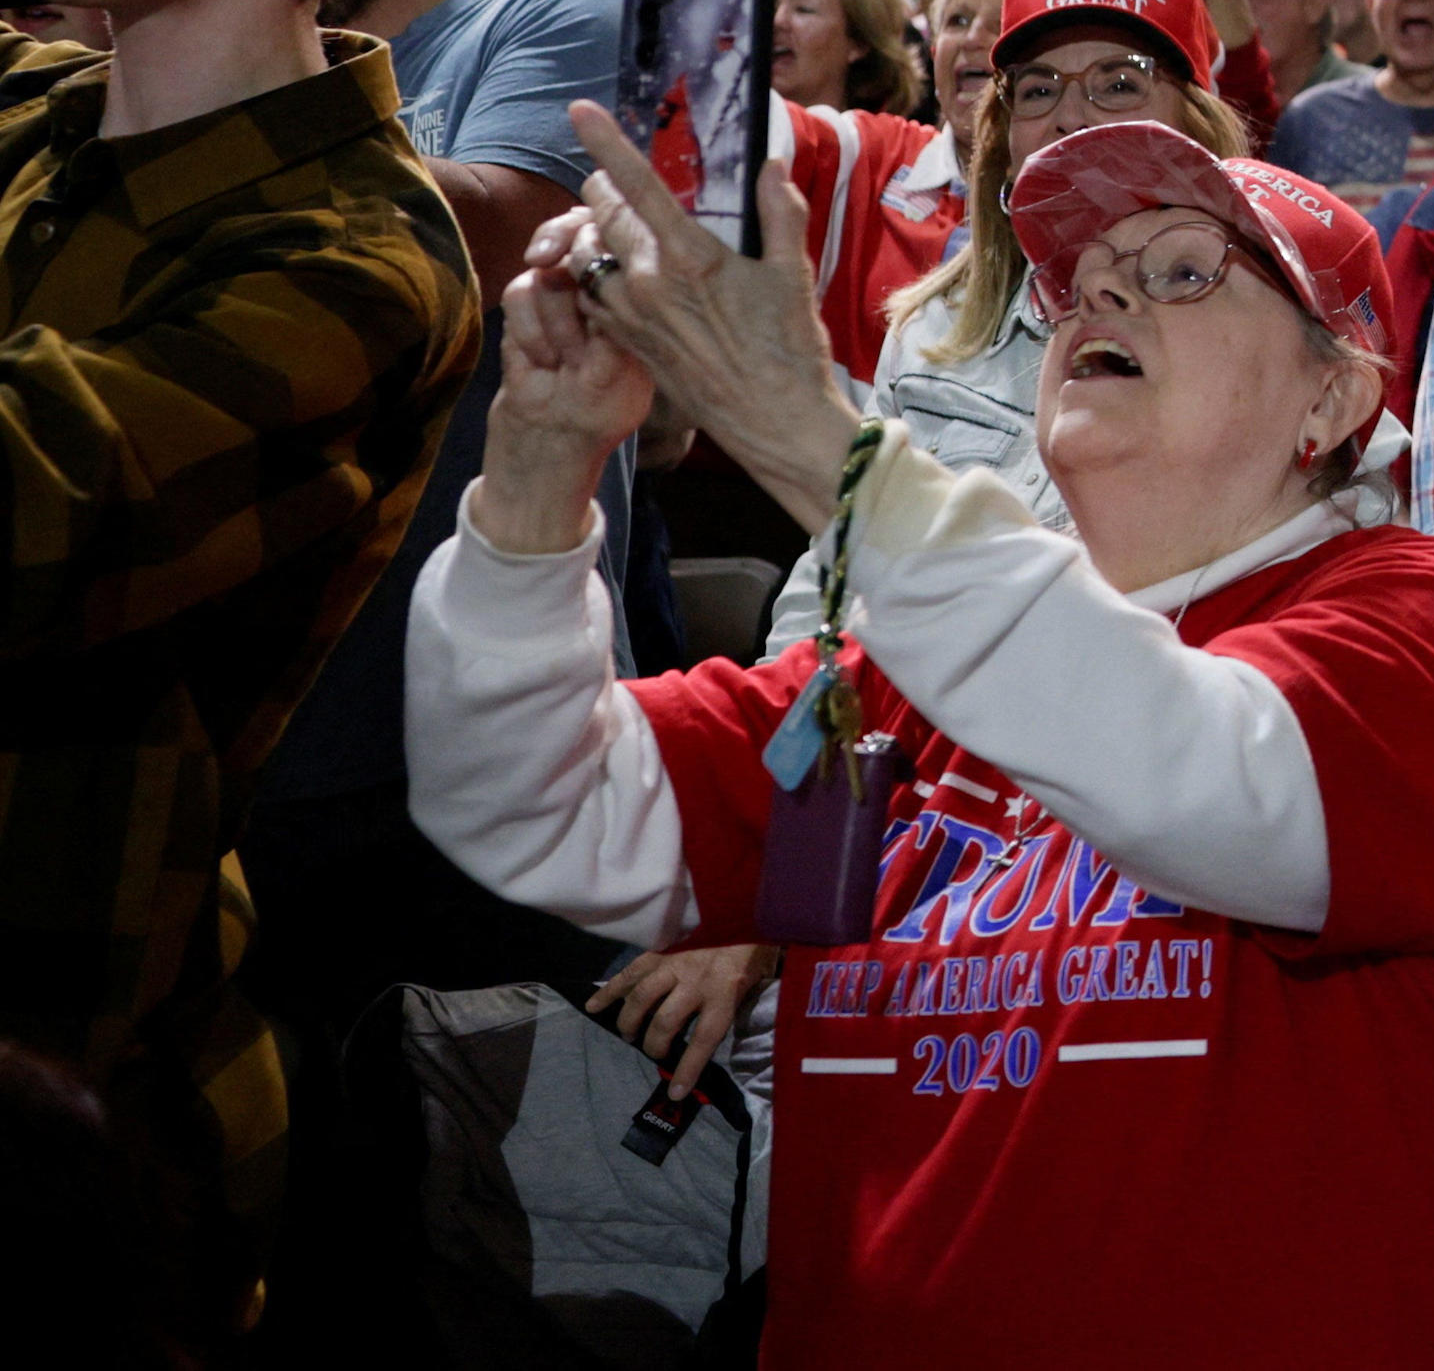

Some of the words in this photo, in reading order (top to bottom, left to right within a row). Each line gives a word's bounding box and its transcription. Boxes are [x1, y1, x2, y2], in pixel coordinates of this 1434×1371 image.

[1212, 159, 1335, 230] AMERICA
[806, 960, 885, 1018] KEEP
[884, 949, 1045, 1018] AMERICA
[1056, 938, 1213, 1006] GREAT!
[912, 1026, 1041, 1097] 2020
